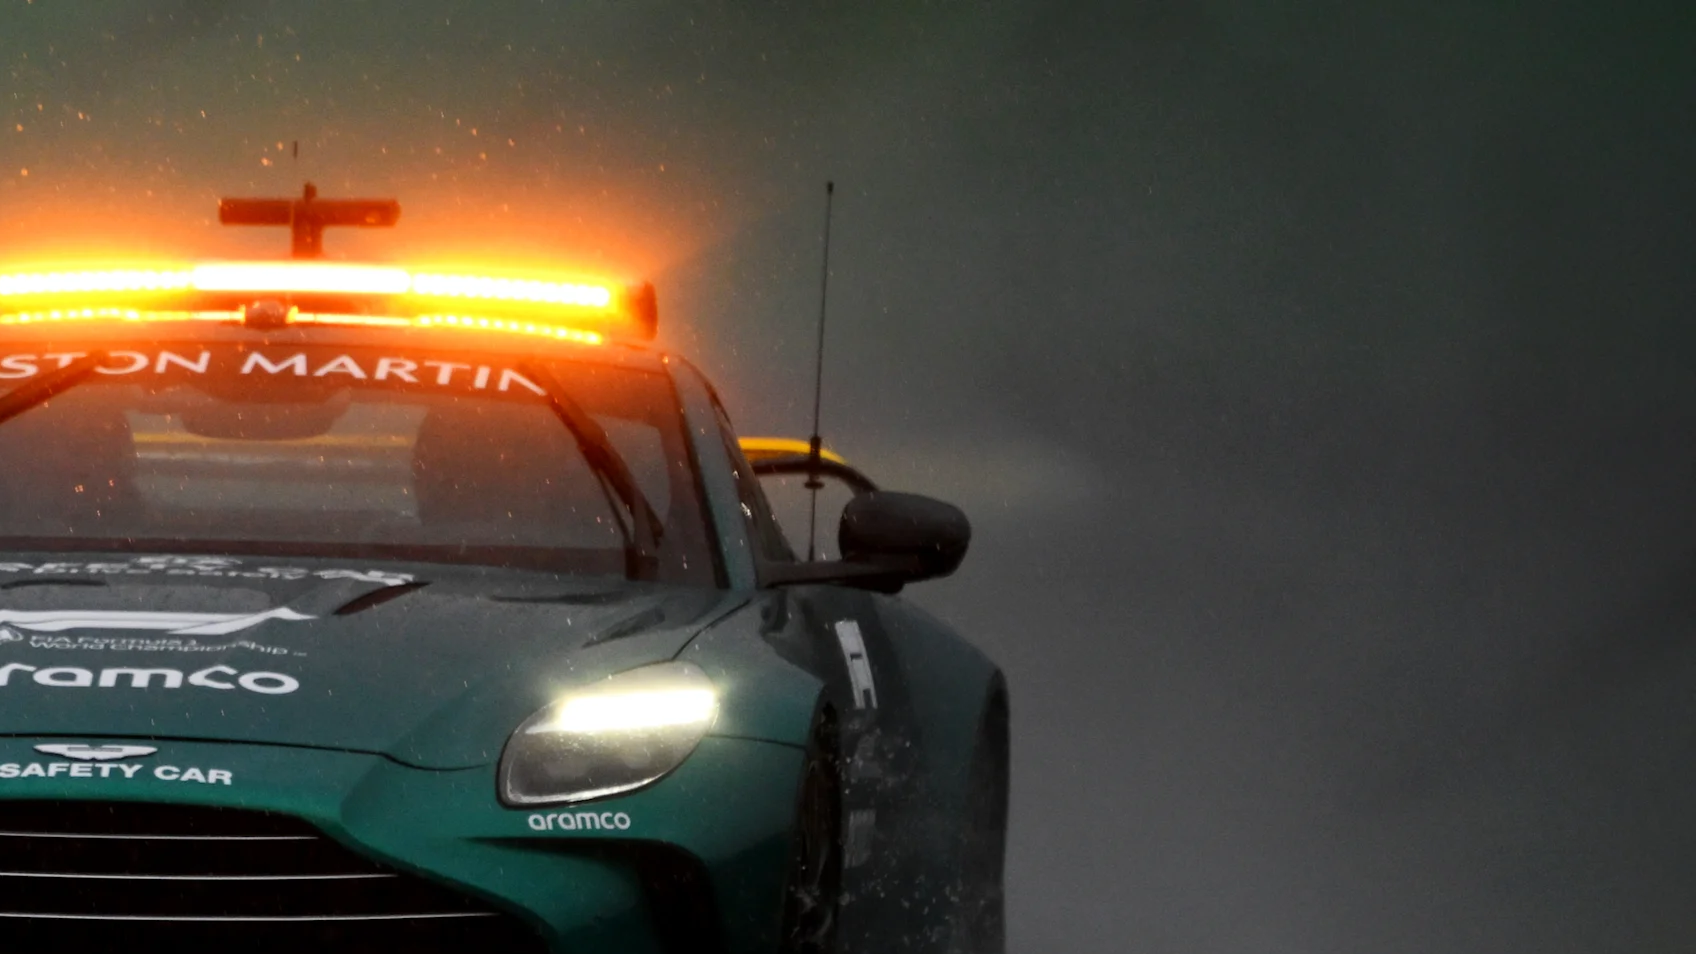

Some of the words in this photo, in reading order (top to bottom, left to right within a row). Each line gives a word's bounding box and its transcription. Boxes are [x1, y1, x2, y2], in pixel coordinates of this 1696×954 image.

[240, 351, 548, 396] MARTIN
[154, 765, 233, 786] CAR
[527, 811, 632, 831] aramco
